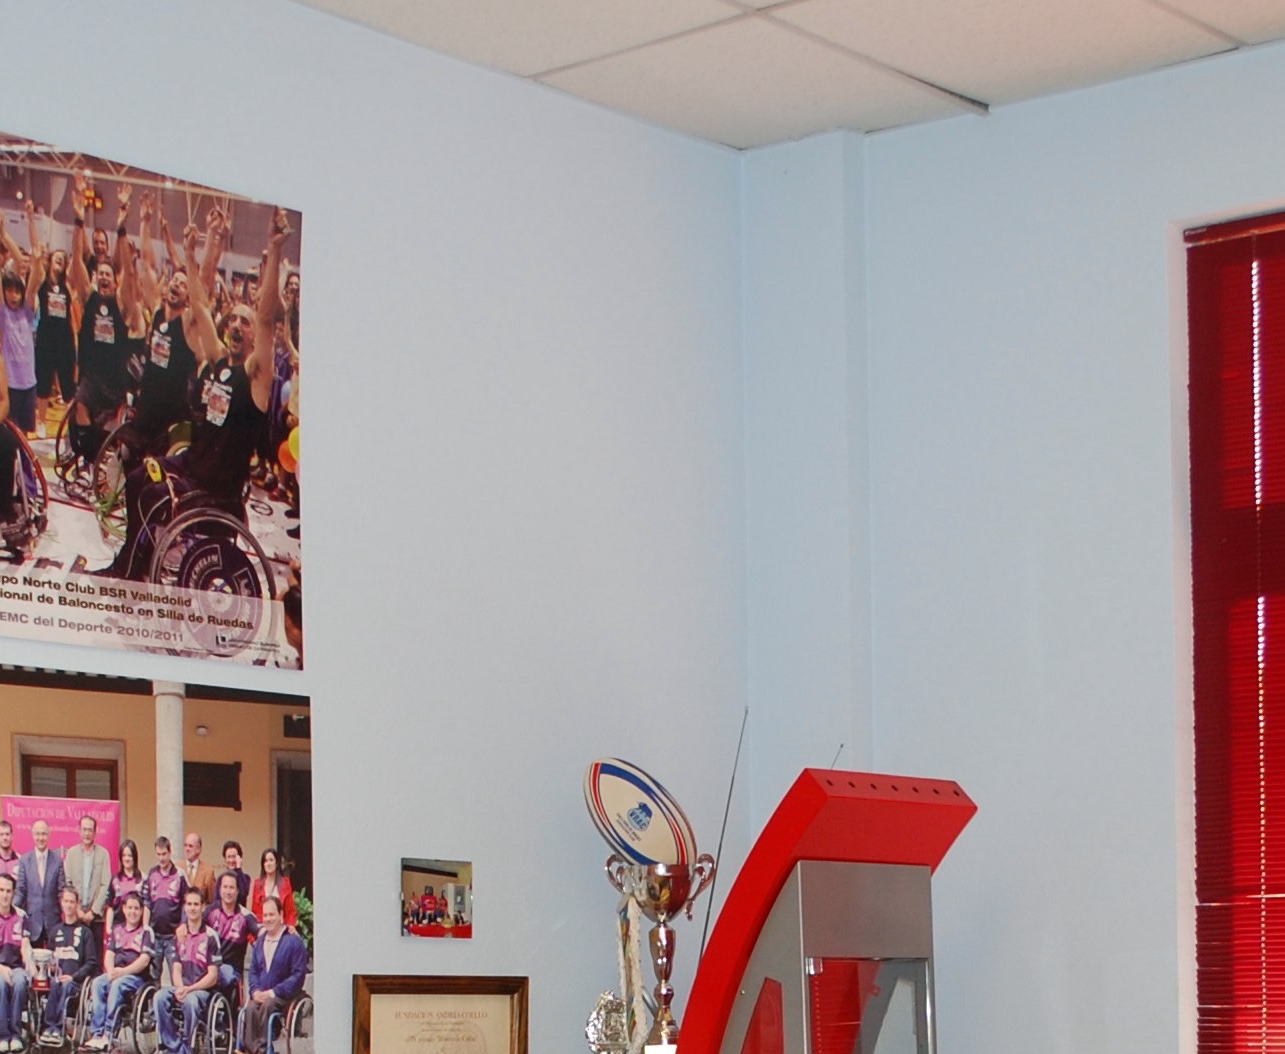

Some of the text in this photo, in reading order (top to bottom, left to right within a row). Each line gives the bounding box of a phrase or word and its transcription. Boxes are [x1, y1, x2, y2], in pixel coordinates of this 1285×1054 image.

[23, 576, 61, 591] Norte
[65, 582, 95, 595] Club
[99, 586, 127, 599] BSR
[130, 590, 192, 607] Valladolid
[37, 592, 54, 604] de
[59, 595, 134, 615] Baloncesto
[137, 607, 154, 618] en
[157, 608, 184, 621] Silla
[188, 612, 204, 624] de
[207, 615, 254, 630] Ruedas
[34, 615, 54, 628] del
[59, 618, 113, 634] Deporte
[116, 626, 184, 643] 2010/2011
